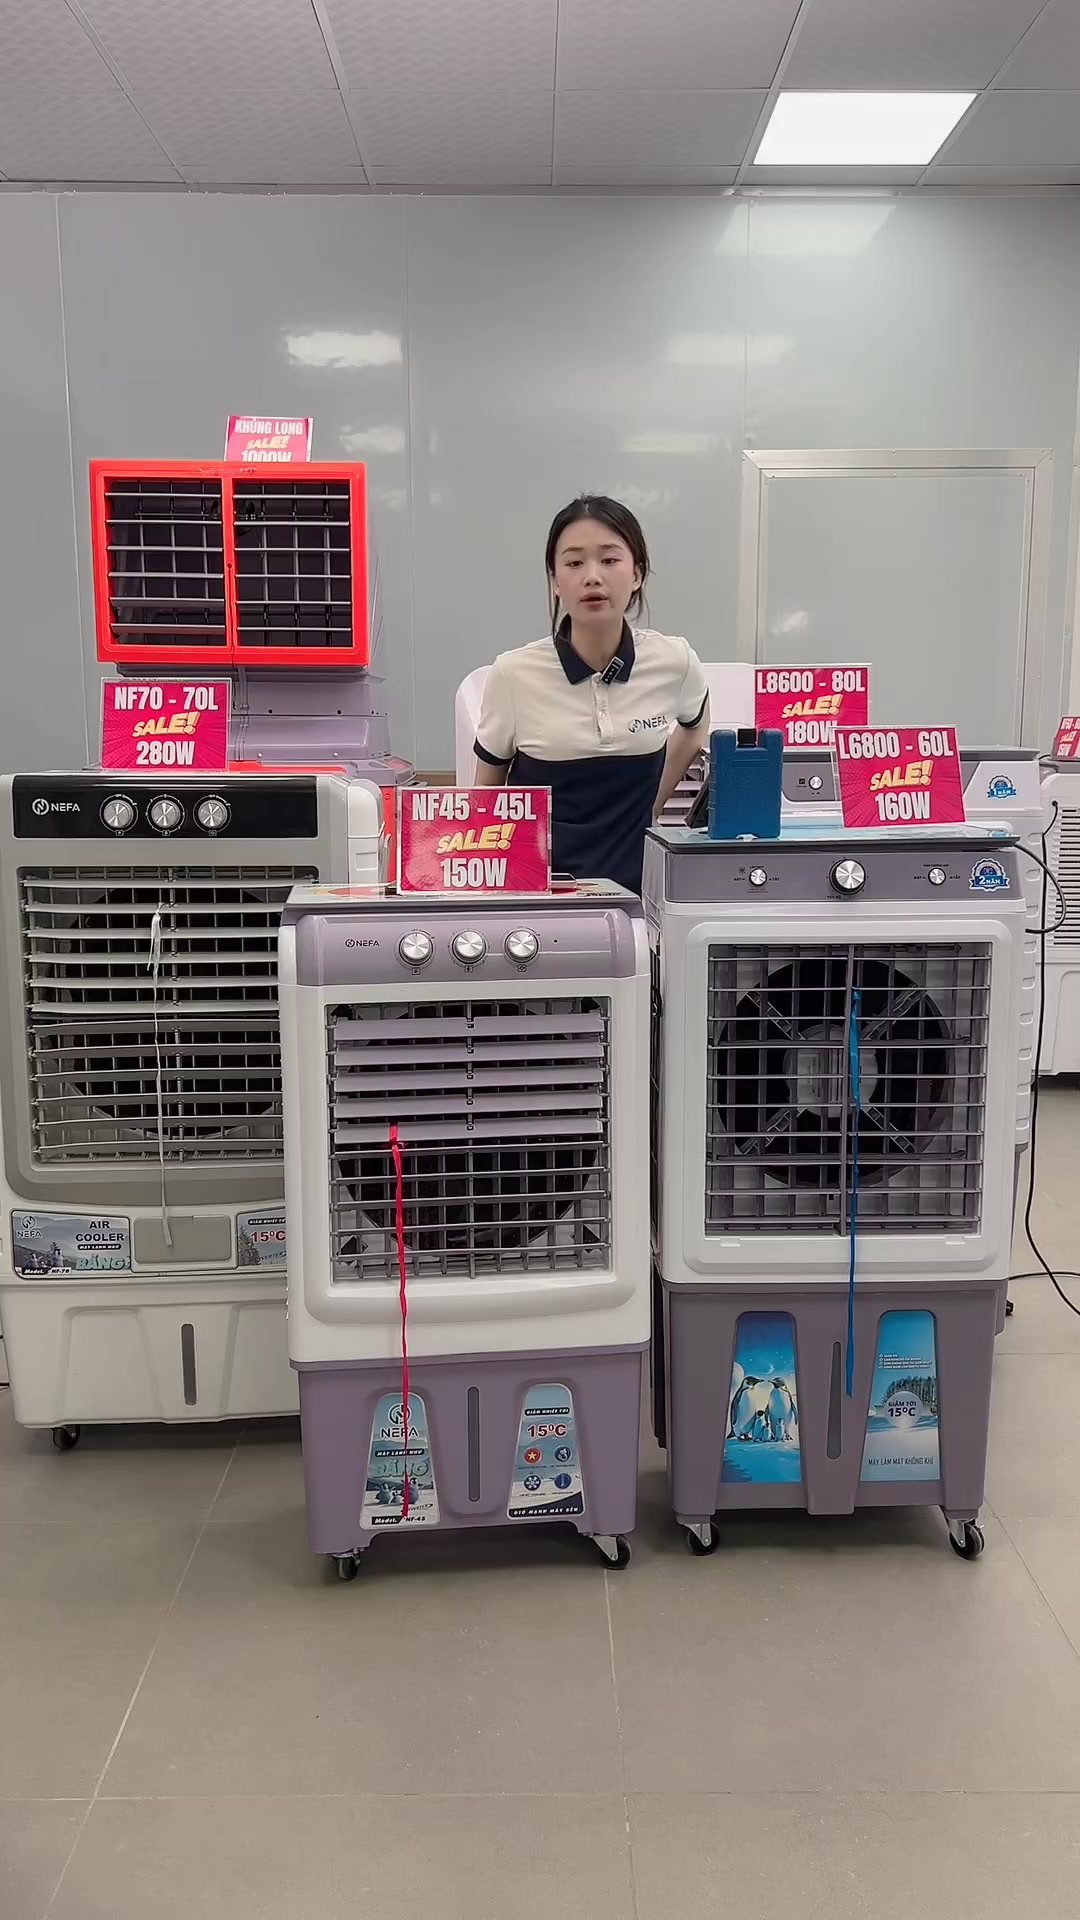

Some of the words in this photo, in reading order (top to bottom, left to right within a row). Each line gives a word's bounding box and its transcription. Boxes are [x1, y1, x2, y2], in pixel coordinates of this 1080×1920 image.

[275, 422, 303, 435] LONG
[245, 435, 291, 449] SALE!
[757, 671, 813, 693] L8600
[831, 671, 865, 692] 80L
[114, 686, 163, 710] NF70
[183, 687, 219, 710] 70L
[781, 693, 843, 718] SALE!
[132, 711, 201, 738] SALE!
[643, 715, 668, 729] NEFA
[785, 720, 838, 744] 180W
[136, 740, 195, 766] 280W
[838, 732, 900, 760] L6800
[917, 731, 954, 757] 60L
[869, 759, 934, 791] SALE!
[51, 802, 81, 812] NEFA
[412, 793, 470, 821] NF45
[493, 793, 537, 821] 45L
[875, 791, 930, 821] 160W
[436, 822, 517, 854] SALE!
[440, 857, 507, 888] 150W
[979, 876, 986, 885] 2
[17, 1230, 41, 1238] NEFA
[89, 1220, 110, 1229] AIR
[75, 1233, 124, 1242] COOLER
